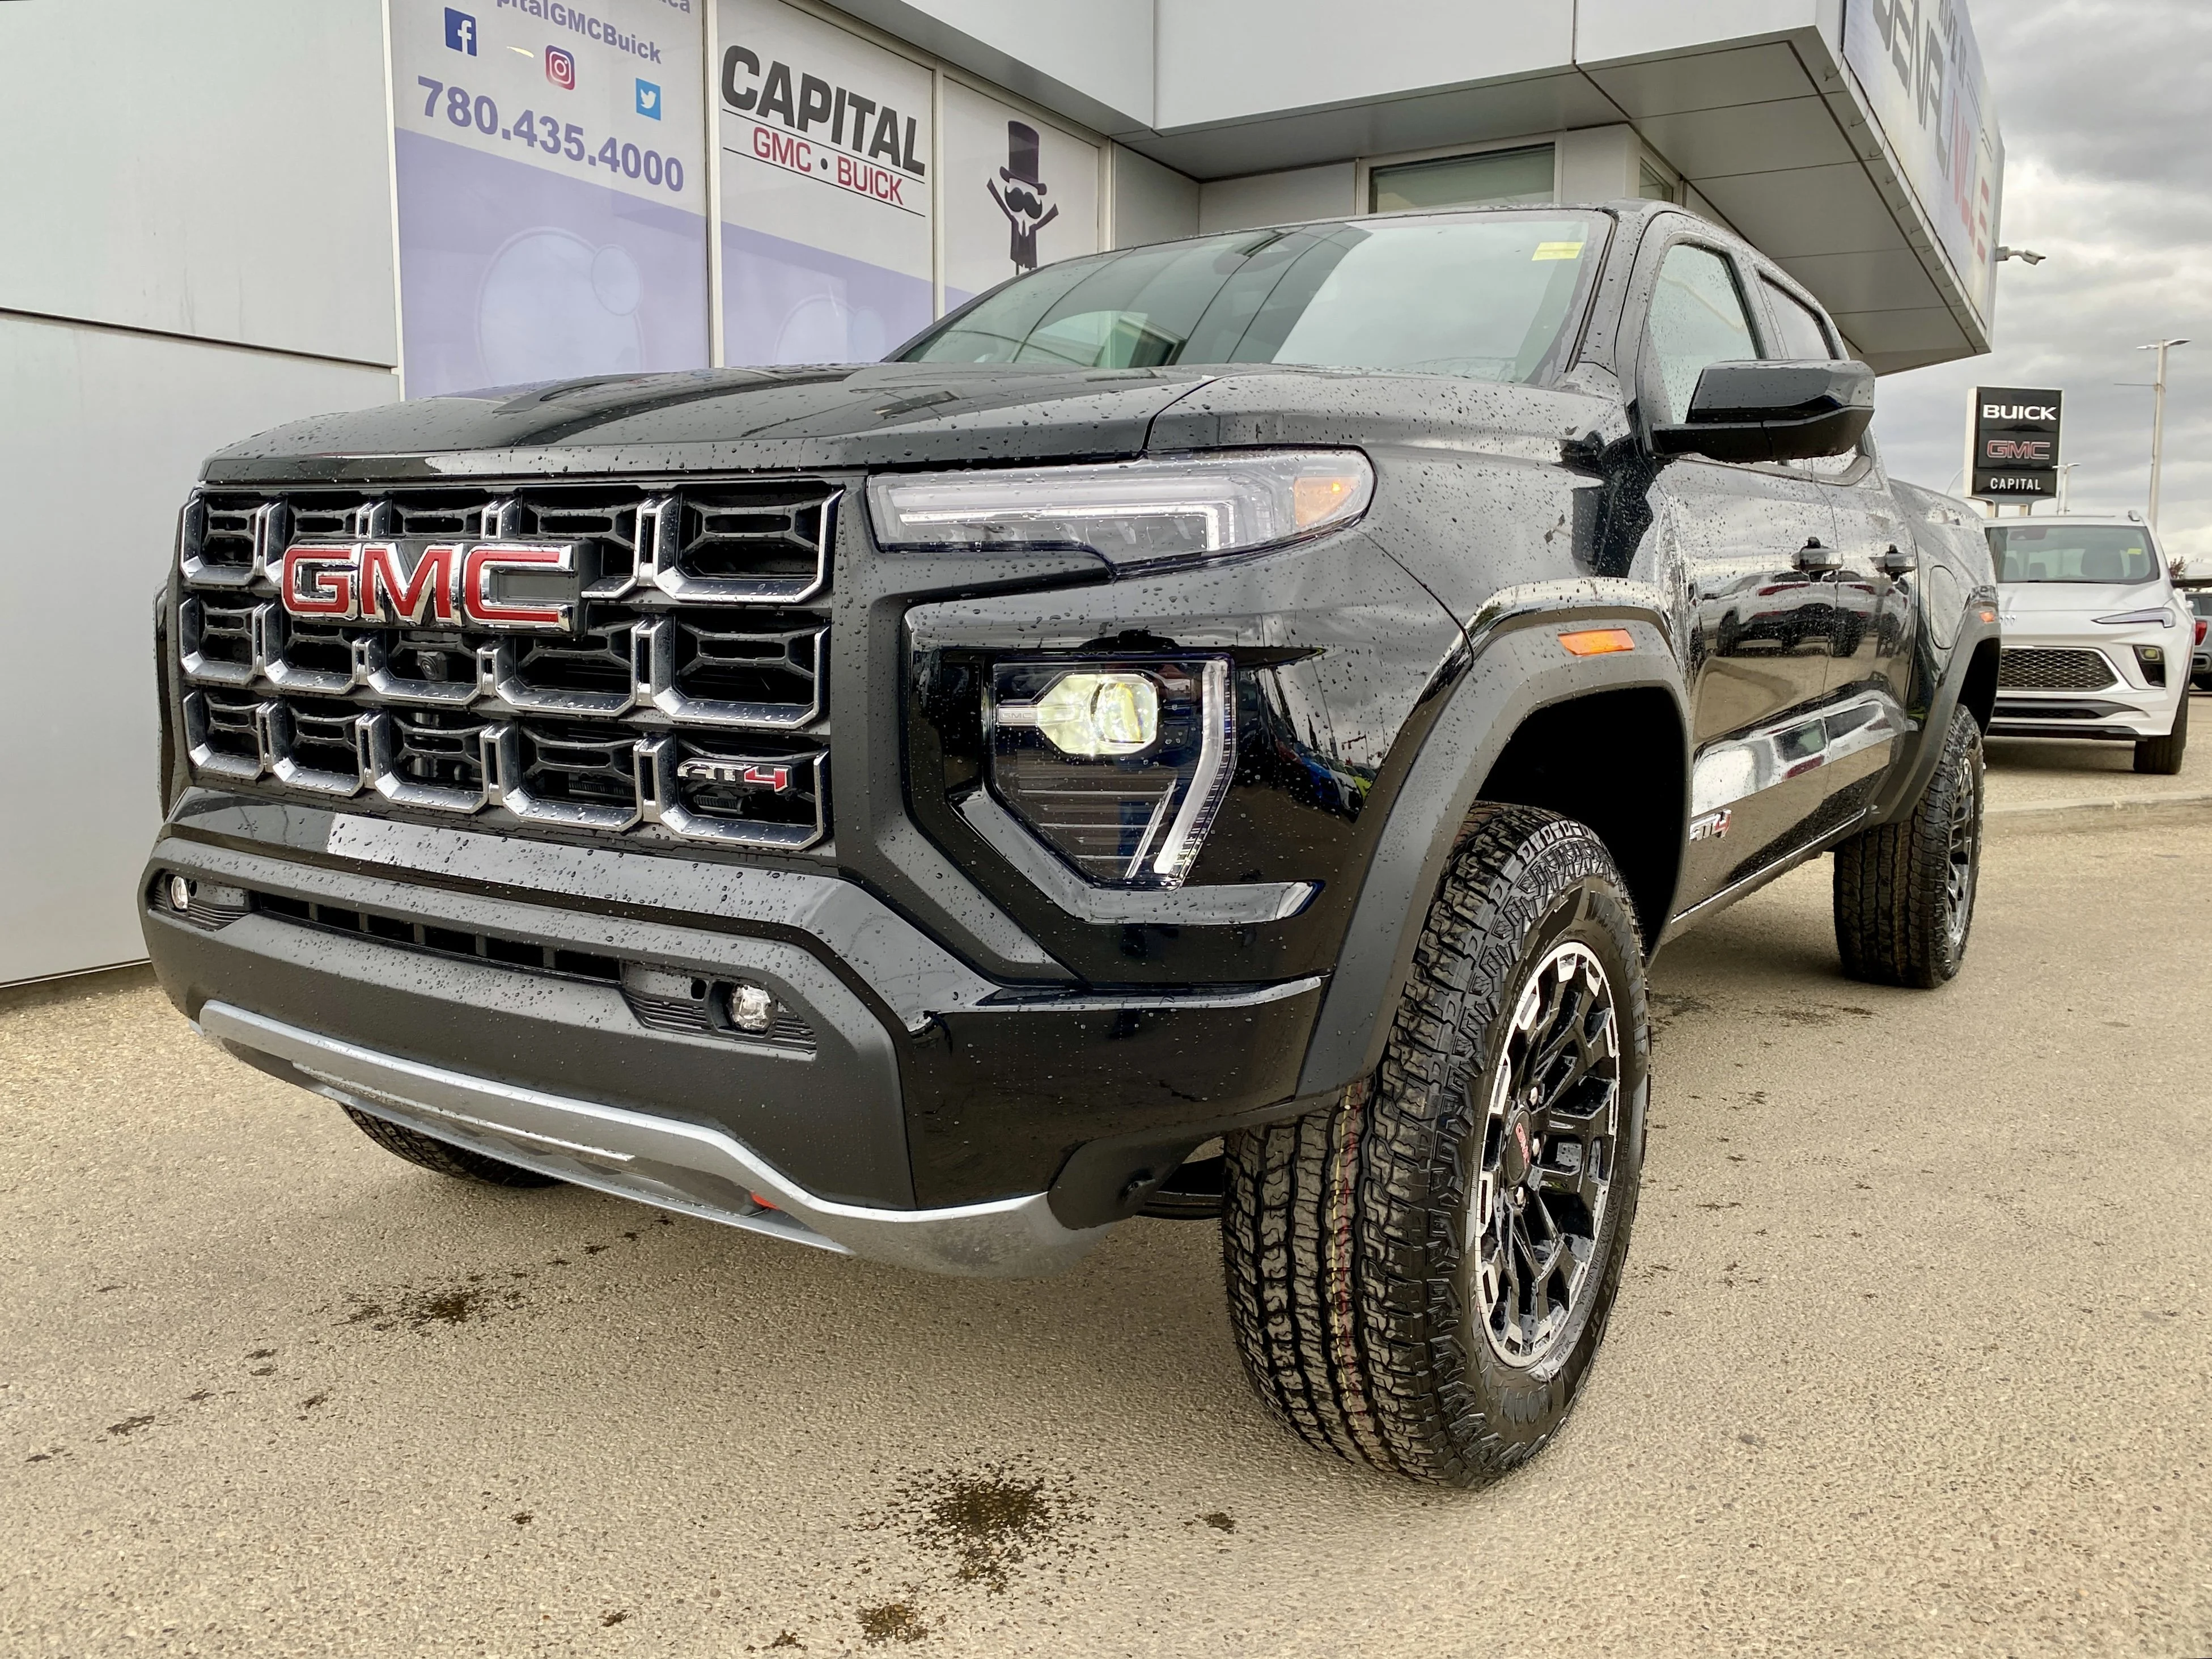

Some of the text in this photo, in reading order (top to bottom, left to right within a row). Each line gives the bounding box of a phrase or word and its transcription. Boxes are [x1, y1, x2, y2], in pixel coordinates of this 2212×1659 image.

[418, 75, 684, 192] 780.435.4000
[722, 45, 925, 176] CAPITAL
[753, 127, 904, 205] GMC BUICK
[1982, 404, 2057, 420] BUICK
[1987, 440, 2050, 460] GMC
[1990, 478, 2041, 490] CAPITAL
[282, 542, 574, 632] GMC
